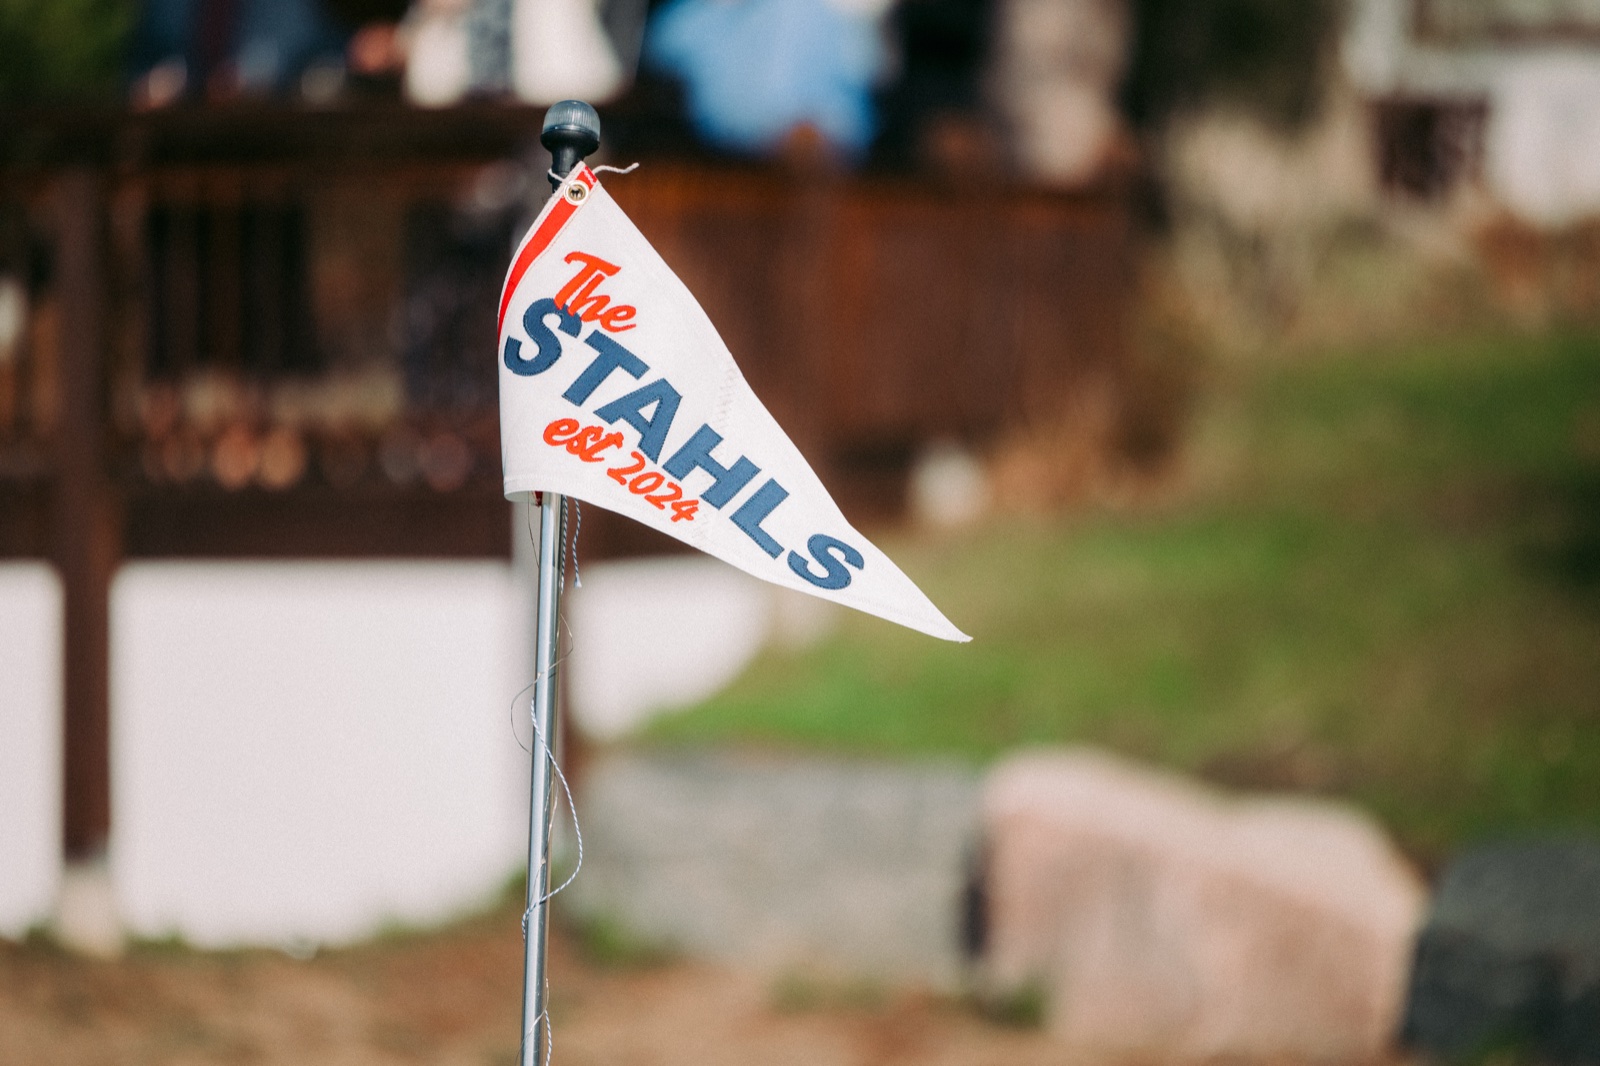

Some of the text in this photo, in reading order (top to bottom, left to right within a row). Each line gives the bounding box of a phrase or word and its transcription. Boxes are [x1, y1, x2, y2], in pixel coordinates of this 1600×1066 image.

[554, 251, 637, 333] The
[504, 298, 864, 590] STAHLS
[543, 418, 699, 523] est 2024
